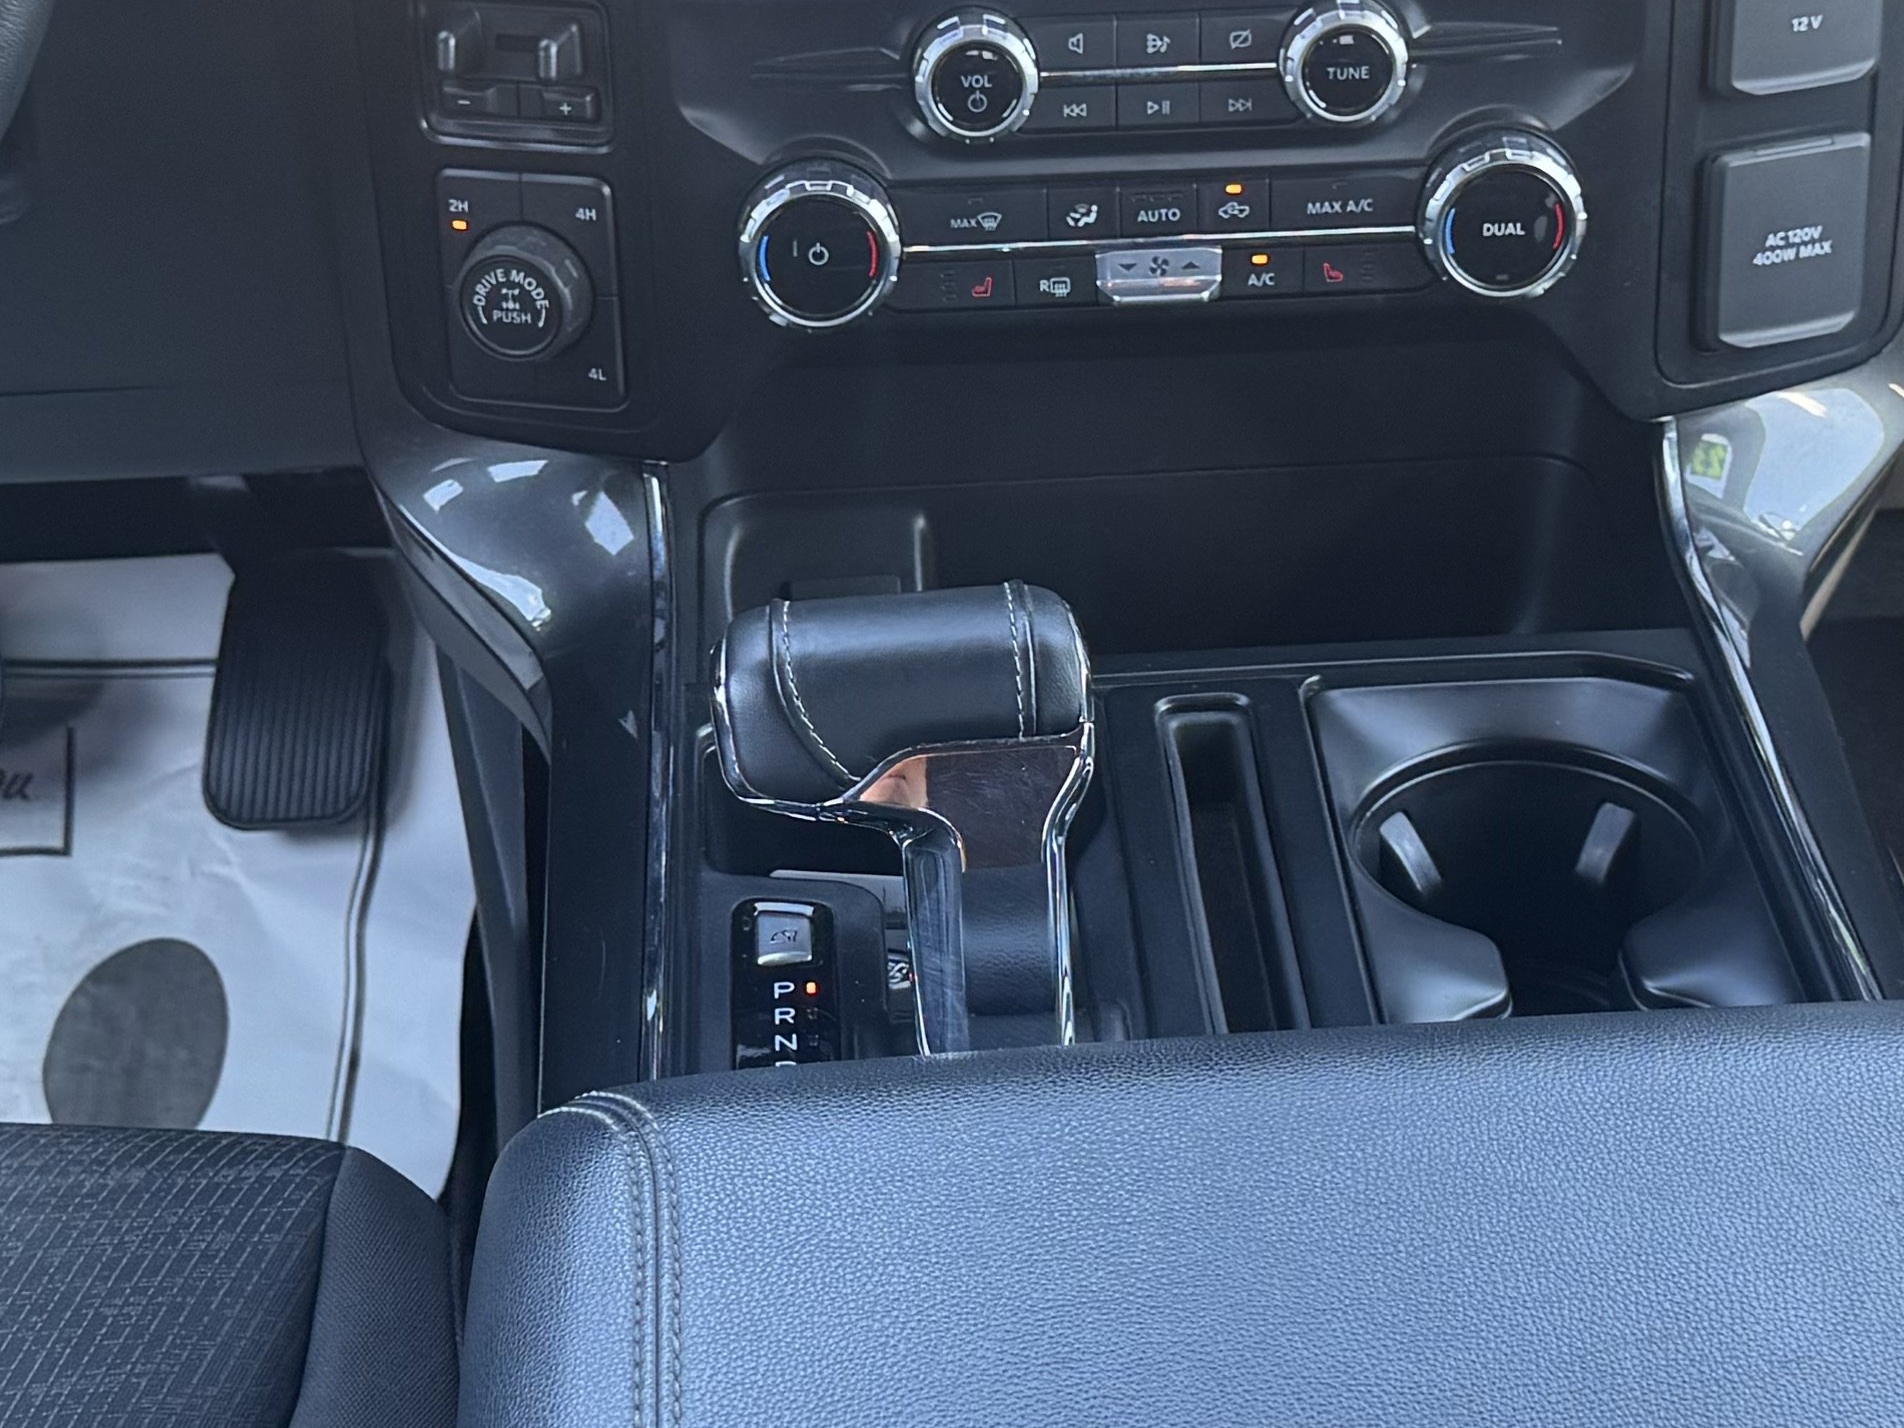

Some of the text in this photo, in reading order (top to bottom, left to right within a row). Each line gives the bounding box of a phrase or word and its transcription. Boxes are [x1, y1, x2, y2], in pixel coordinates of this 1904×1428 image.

[1327, 66, 1370, 81] TUNE
[961, 75, 992, 89] VOL
[448, 199, 469, 213] 2H
[1307, 198, 1373, 215] MAX A/C
[575, 208, 596, 221] 4H
[1137, 207, 1181, 223] AUTO
[950, 217, 977, 229] MAX
[1482, 222, 1526, 237] DUAL
[1765, 226, 1823, 247] AC 120V
[1753, 241, 1832, 266] 400W MAX
[1248, 272, 1276, 286] A/C
[472, 268, 550, 309] DRIVE MODE
[492, 309, 532, 324] PUSH
[588, 367, 607, 381] 4L
[774, 981, 795, 1000] P
[775, 1007, 795, 1025] R
[775, 1034, 798, 1052] N
